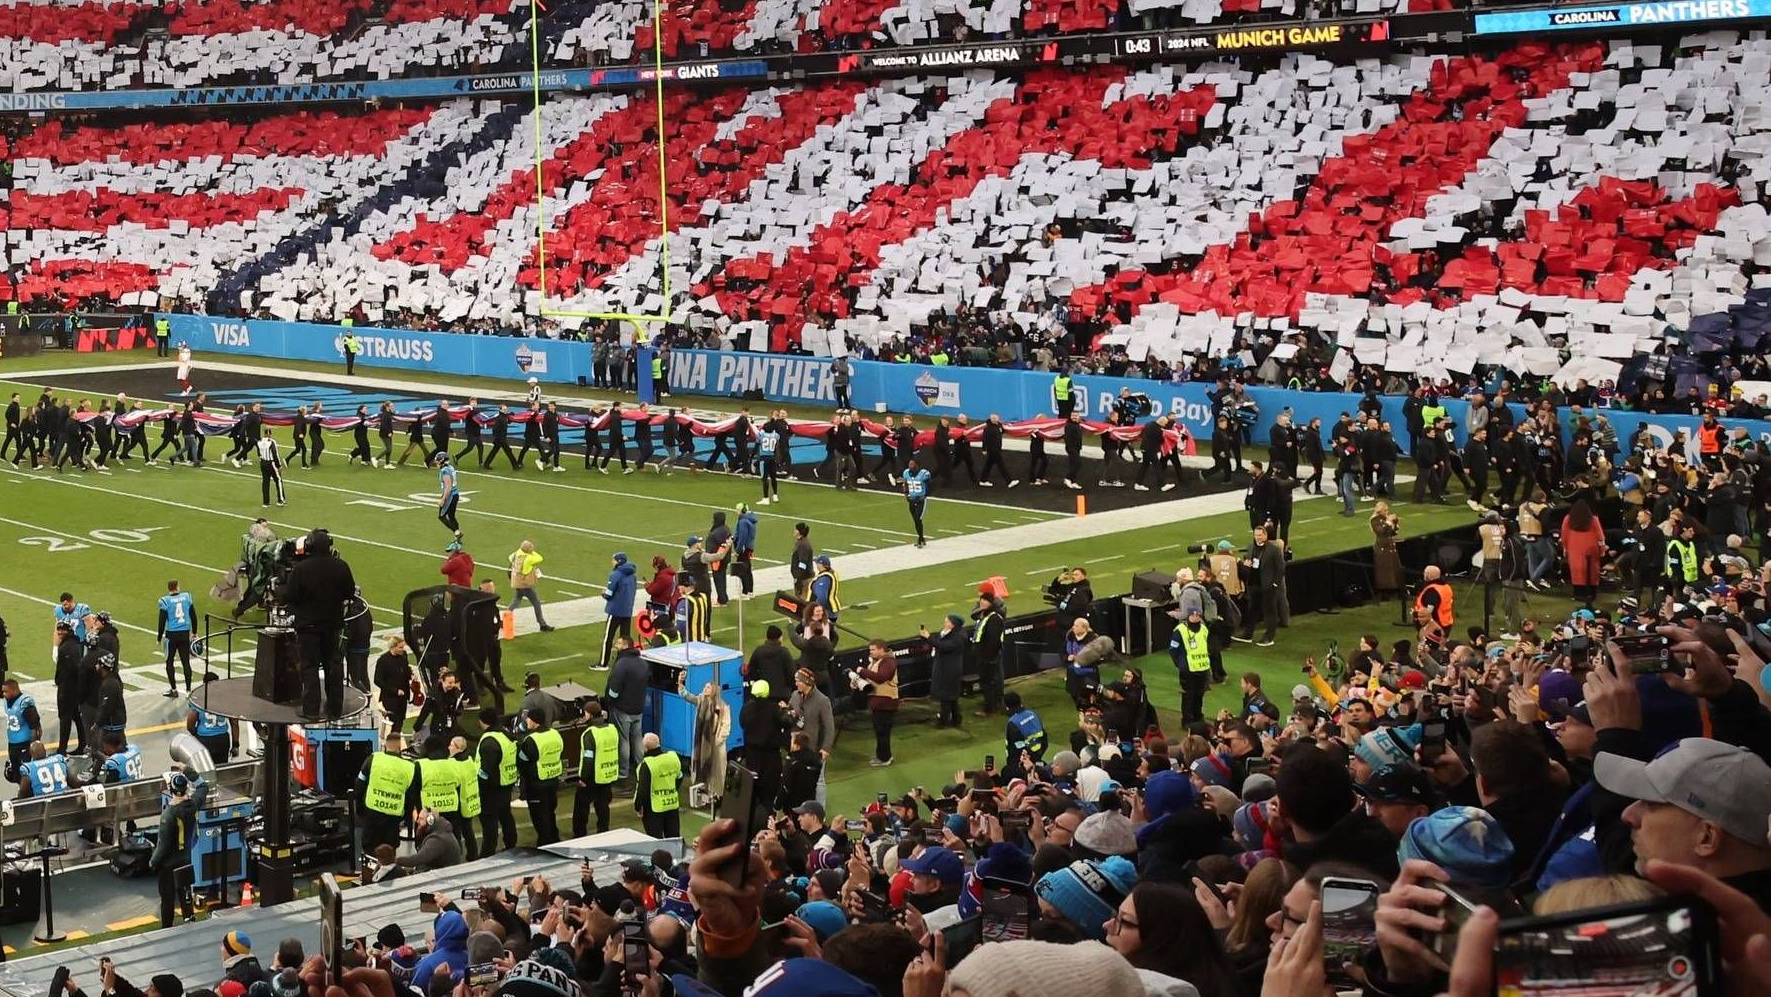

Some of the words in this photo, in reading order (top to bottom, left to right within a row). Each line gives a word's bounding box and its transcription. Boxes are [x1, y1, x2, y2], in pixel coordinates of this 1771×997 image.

[1554, 10, 1617, 25] CAROLINA
[1125, 38, 1151, 54] 0:43
[1167, 38, 1190, 50] 2024
[1191, 36, 1210, 48] NFL
[1217, 28, 1285, 50] MUNICH
[1288, 25, 1341, 46] GAME
[872, 56, 906, 67] WELCOME
[906, 55, 918, 65] TO
[919, 50, 973, 67] ALLIANZ
[975, 47, 1021, 63] ARENA
[472, 75, 518, 90] CAROLINA
[677, 64, 719, 80] GIANTS
[211, 322, 250, 348] VISA
[355, 336, 434, 362] STRAUSS
[717, 354, 855, 401] PANTHER
[1171, 398, 1213, 427] Bay
[761, 437, 777, 452] 20
[17, 528, 152, 553] 20
[174, 603, 185, 622] 4
[292, 744, 305, 771] G
[37, 765, 67, 794] 94
